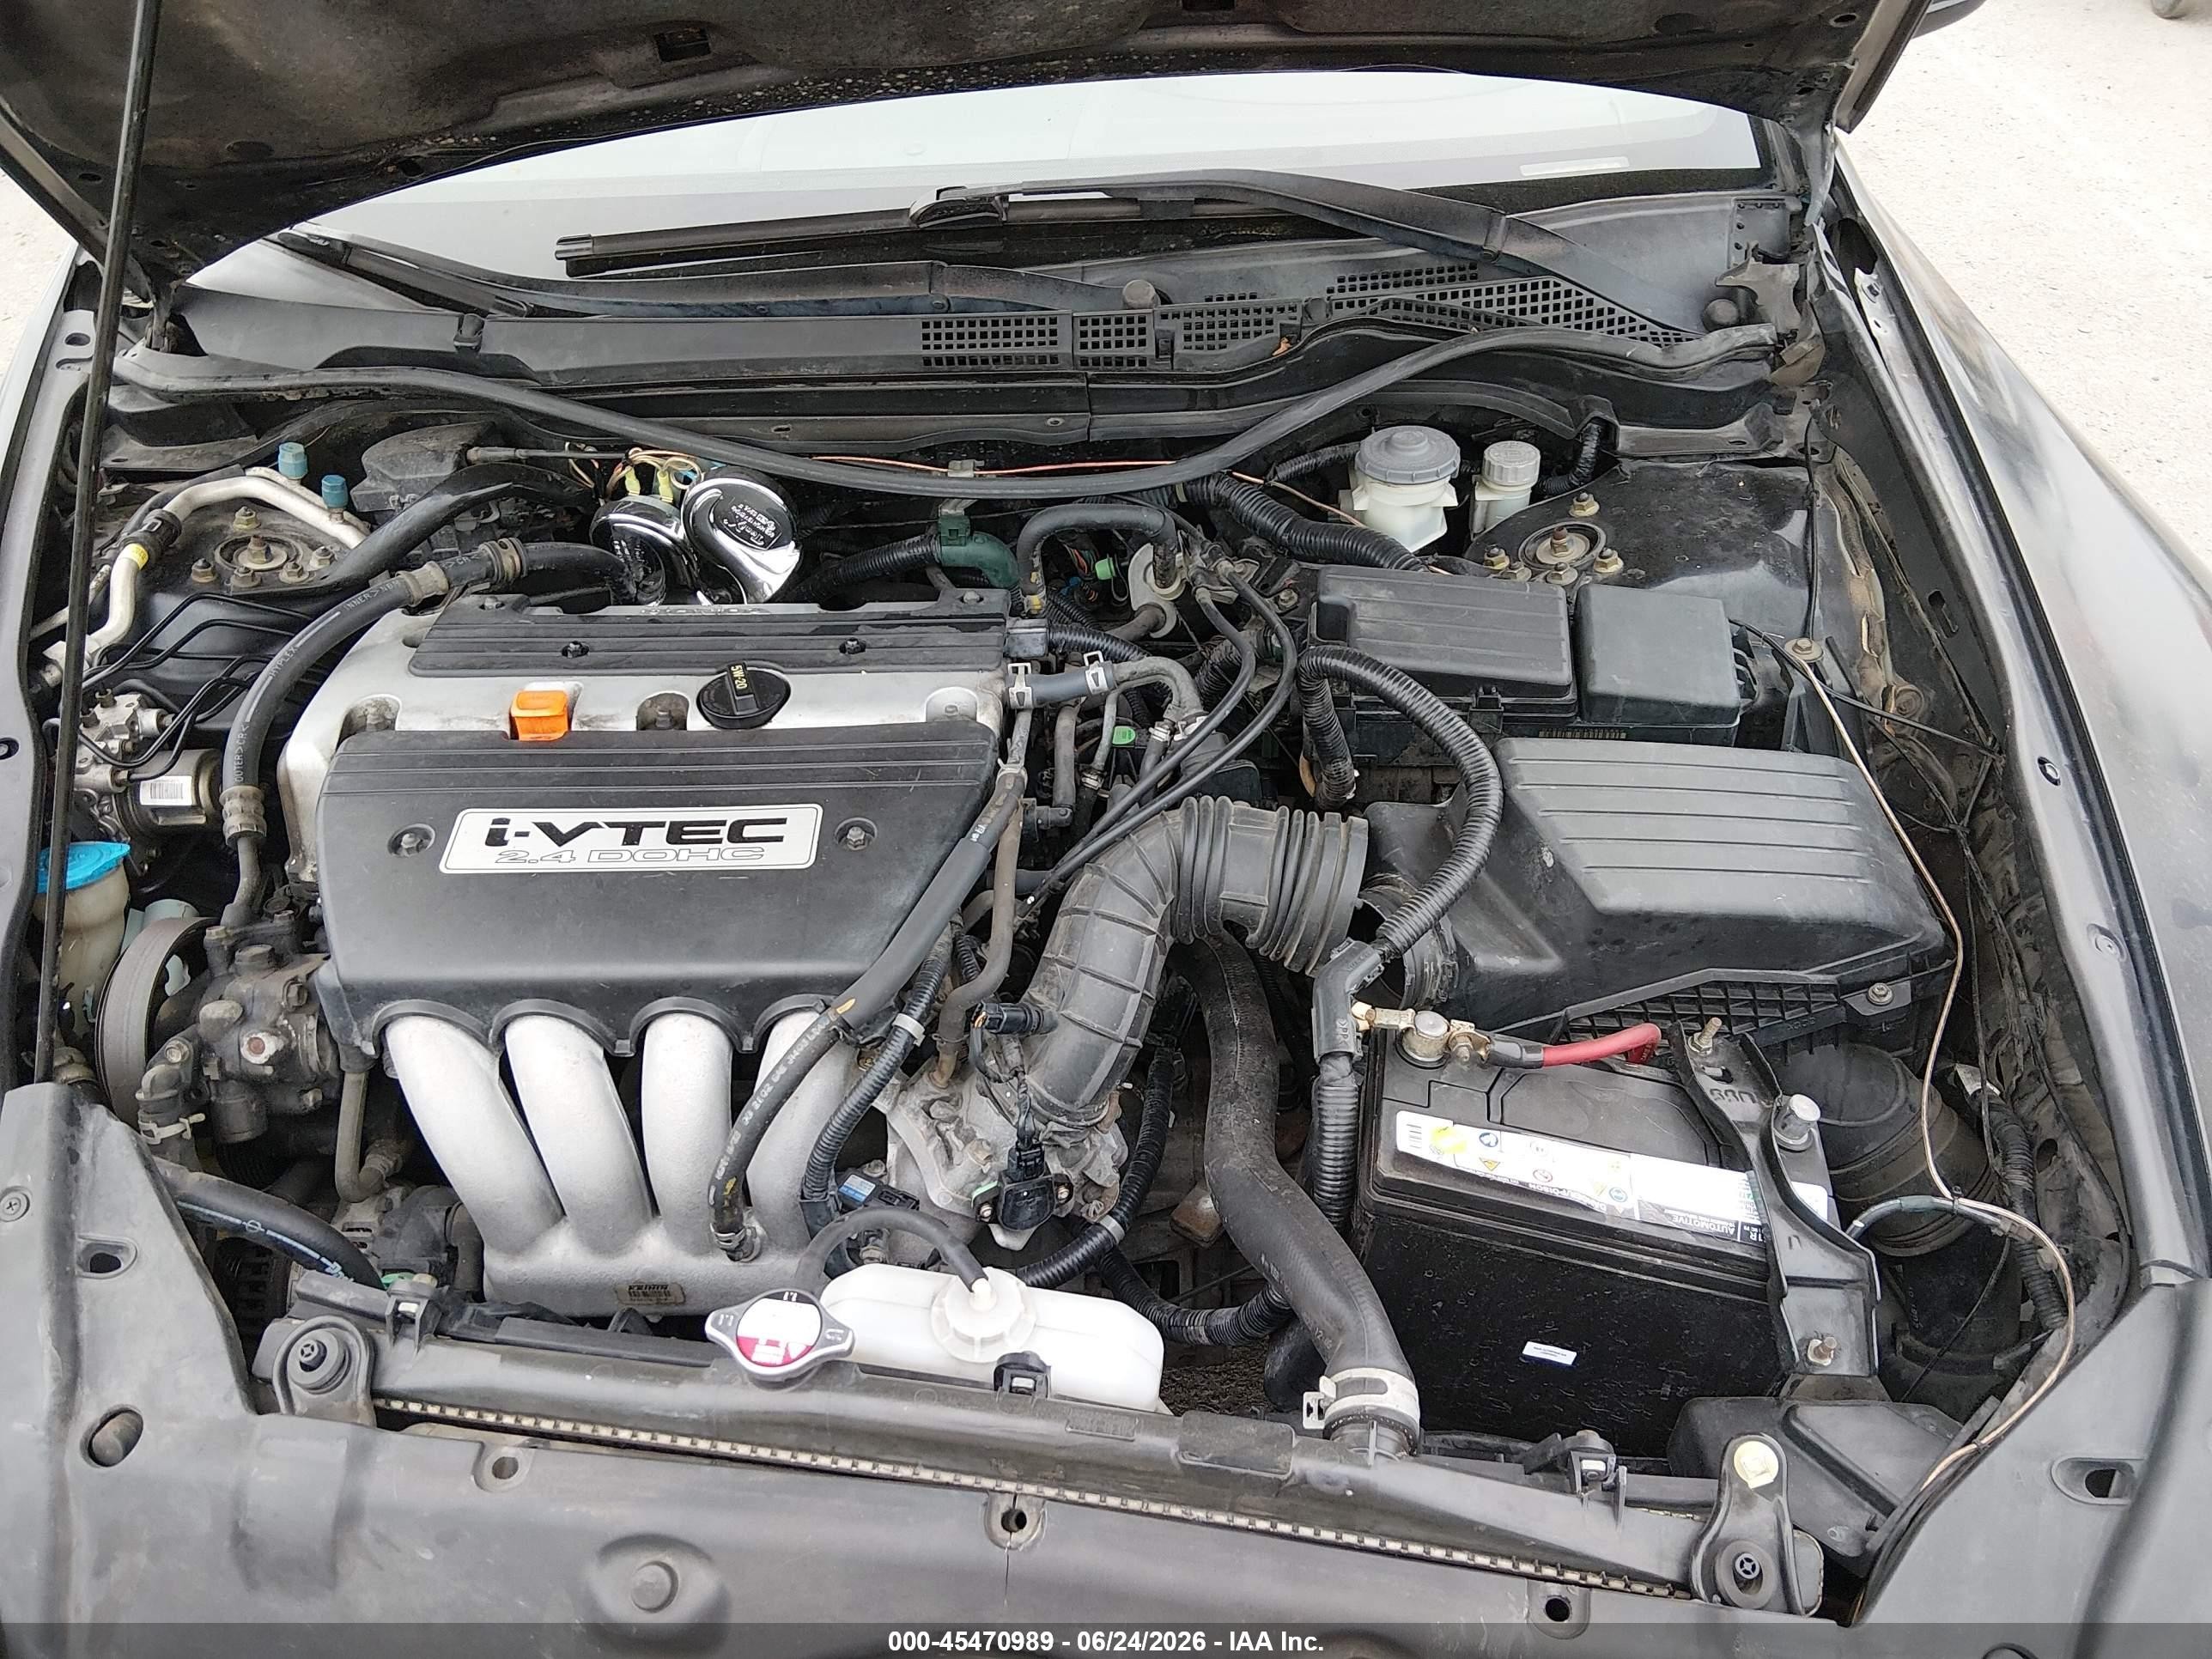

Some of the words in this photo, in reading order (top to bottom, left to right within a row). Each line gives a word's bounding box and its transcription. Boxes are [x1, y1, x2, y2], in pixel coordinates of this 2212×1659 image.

[269, 646, 297, 678] HYPLEX
[730, 665, 748, 689] 5W-20
[484, 817, 787, 848] i-VTEC
[495, 850, 576, 864] 2.4
[587, 847, 765, 862] DOHC
[1672, 1215, 1735, 1234] AUTOMOTIVE
